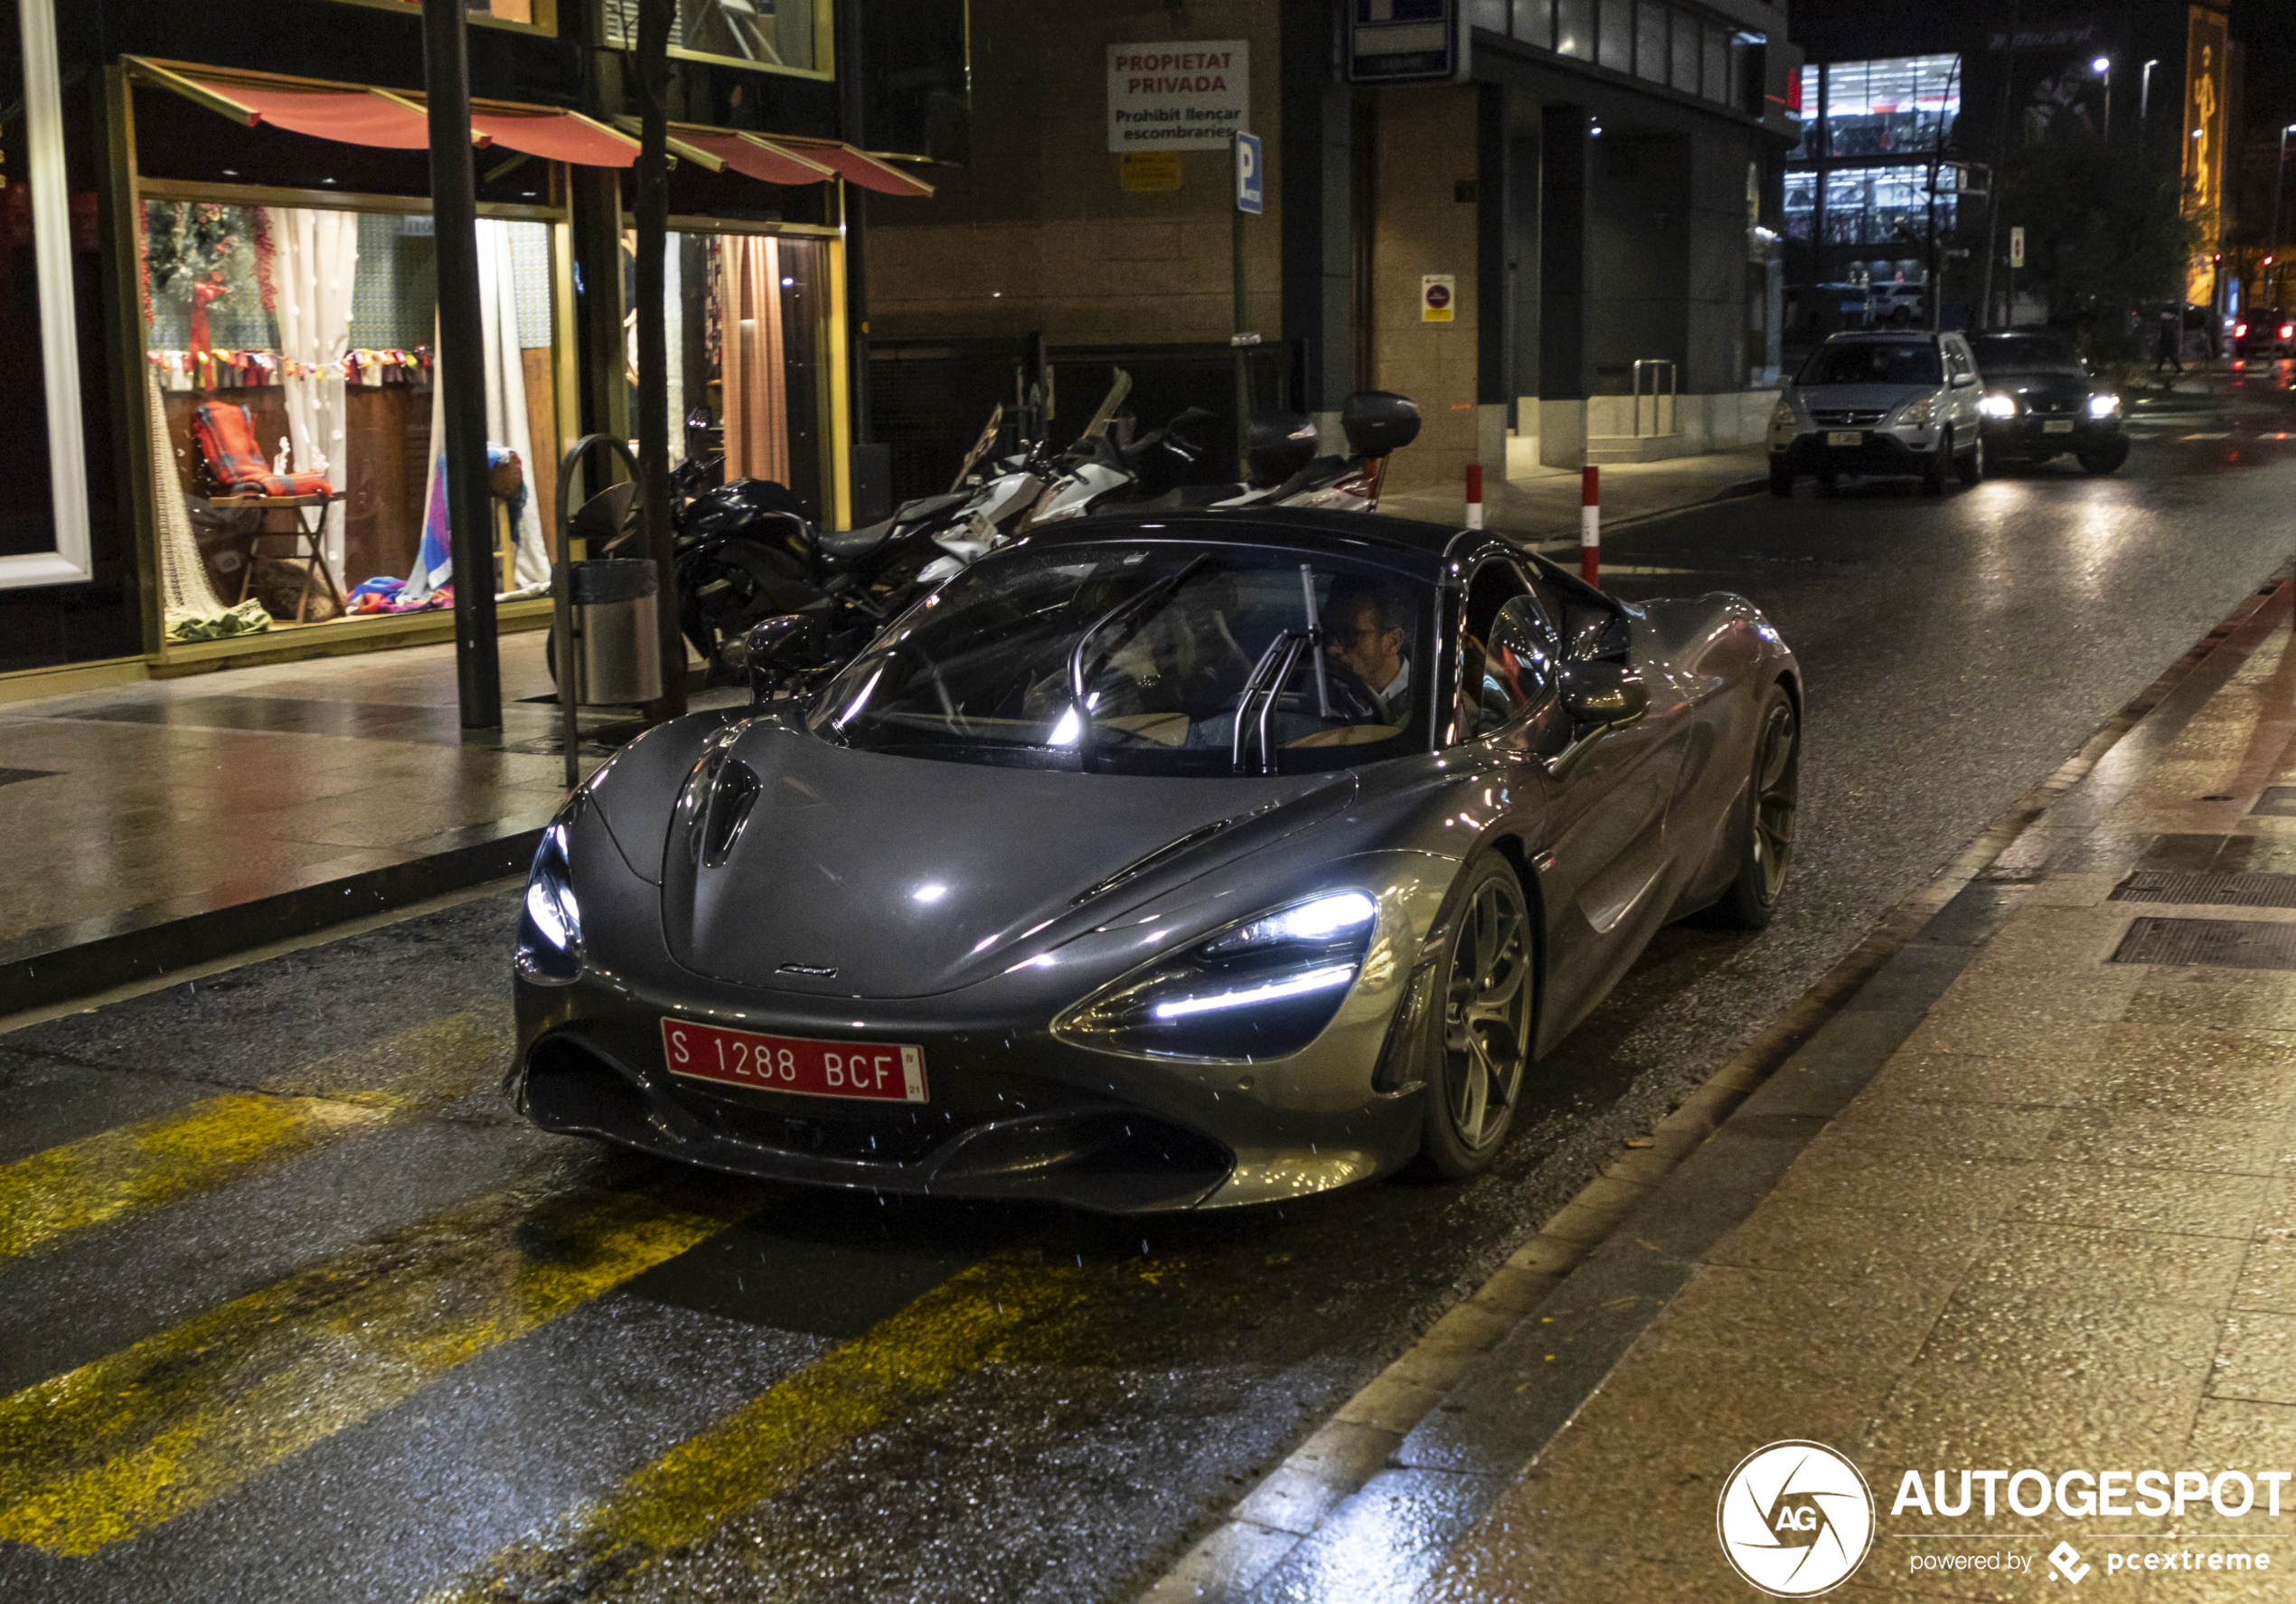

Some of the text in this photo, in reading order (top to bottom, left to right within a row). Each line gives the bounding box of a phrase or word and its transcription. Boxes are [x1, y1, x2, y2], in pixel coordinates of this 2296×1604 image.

[1115, 52, 1232, 71] PROPIETAT
[1129, 76, 1228, 94] PRIVADA
[1115, 108, 1181, 123] Prohibit
[1239, 141, 1255, 198] P
[672, 1031, 892, 1090] S 1288 BCF
[909, 1085, 920, 1095] 21
